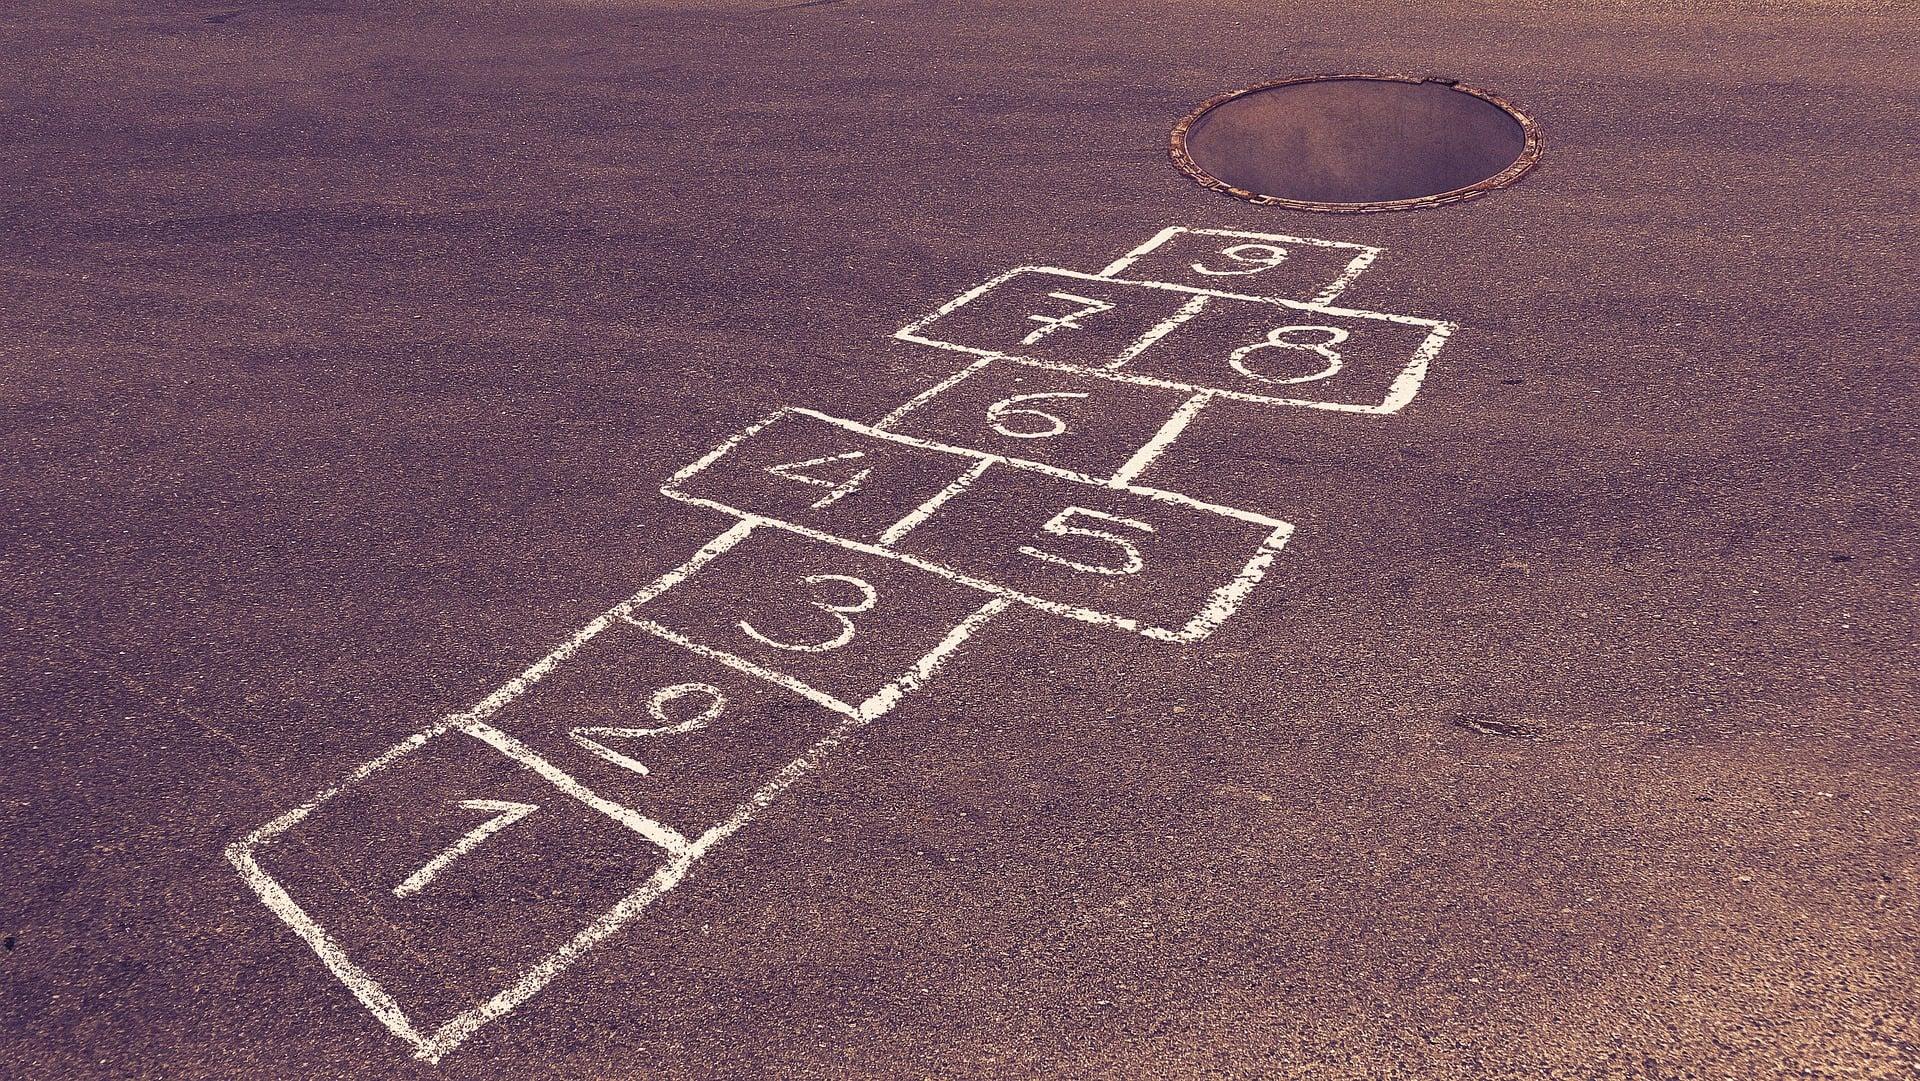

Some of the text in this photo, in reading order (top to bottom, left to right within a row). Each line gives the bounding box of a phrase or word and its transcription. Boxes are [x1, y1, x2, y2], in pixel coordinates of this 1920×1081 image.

[1192, 243, 1288, 276] 9
[1022, 292, 1115, 344] 7
[1229, 326, 1349, 384] 8
[987, 392, 1088, 438] 6
[765, 451, 873, 508] 4
[1019, 506, 1154, 577] 5
[738, 575, 877, 652] 3
[569, 683, 727, 776] 2
[393, 799, 539, 898] 1
